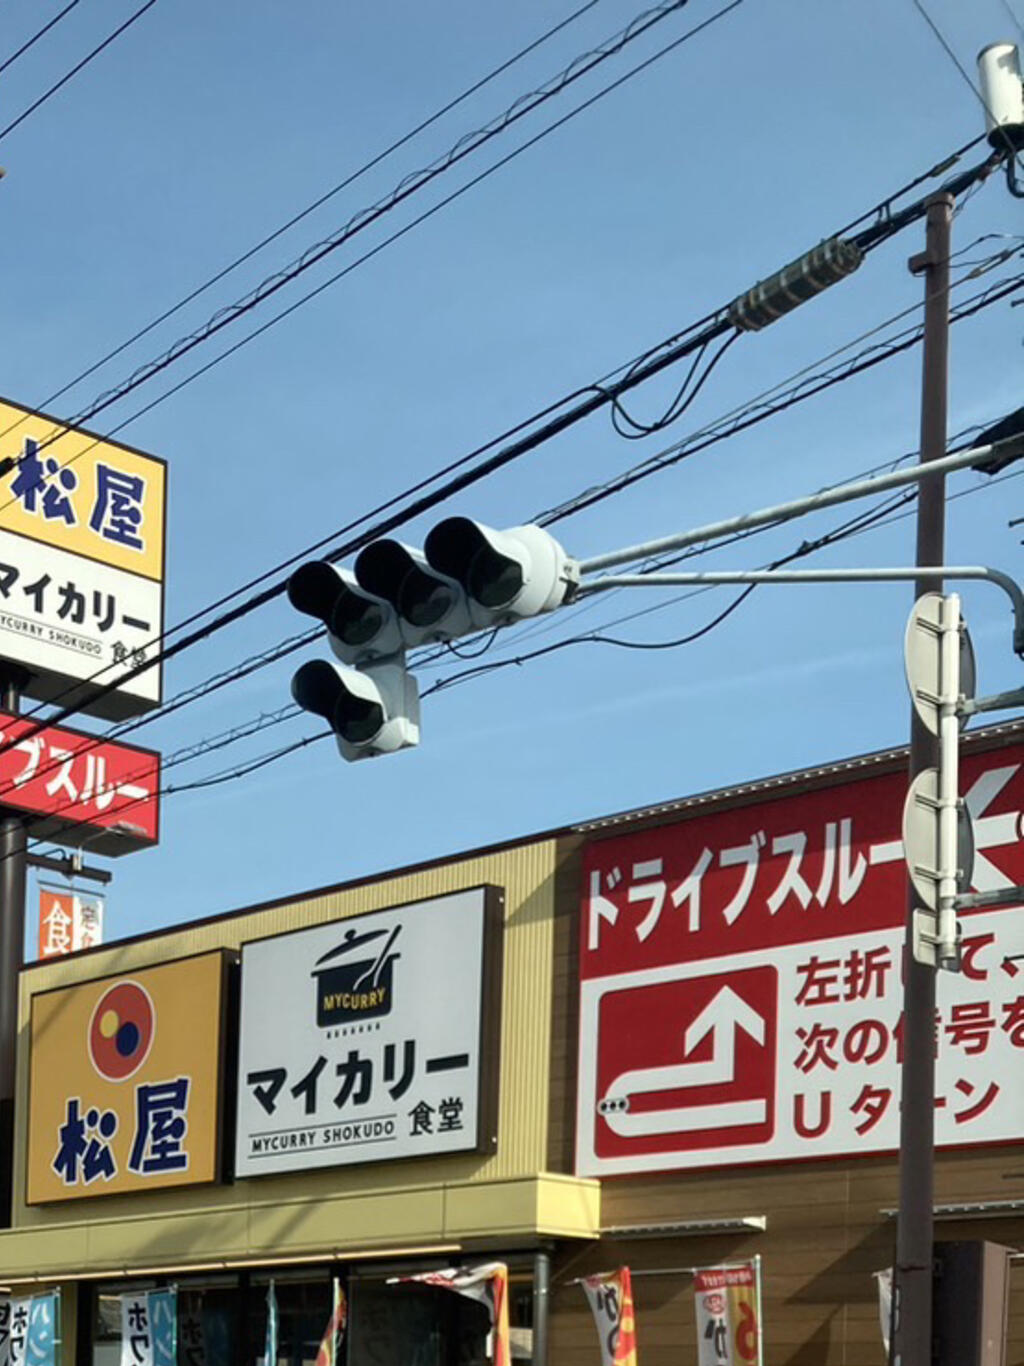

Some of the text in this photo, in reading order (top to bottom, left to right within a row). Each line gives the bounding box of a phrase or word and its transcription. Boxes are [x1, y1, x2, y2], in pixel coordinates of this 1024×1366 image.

[11, 439, 145, 551] 松屋
[48, 630, 102, 655] SHOKUDO
[587, 817, 905, 950] ドライブスルー
[324, 986, 386, 1012] MYCURRY
[793, 932, 1019, 1006] 左折て、
[247, 1040, 469, 1116] マイカリー
[792, 1079, 1001, 1138] Uタン
[53, 1078, 190, 1184] 松屋
[251, 1119, 395, 1153] MYCURRY SHOKUDO
[407, 1096, 464, 1138] 食堂
